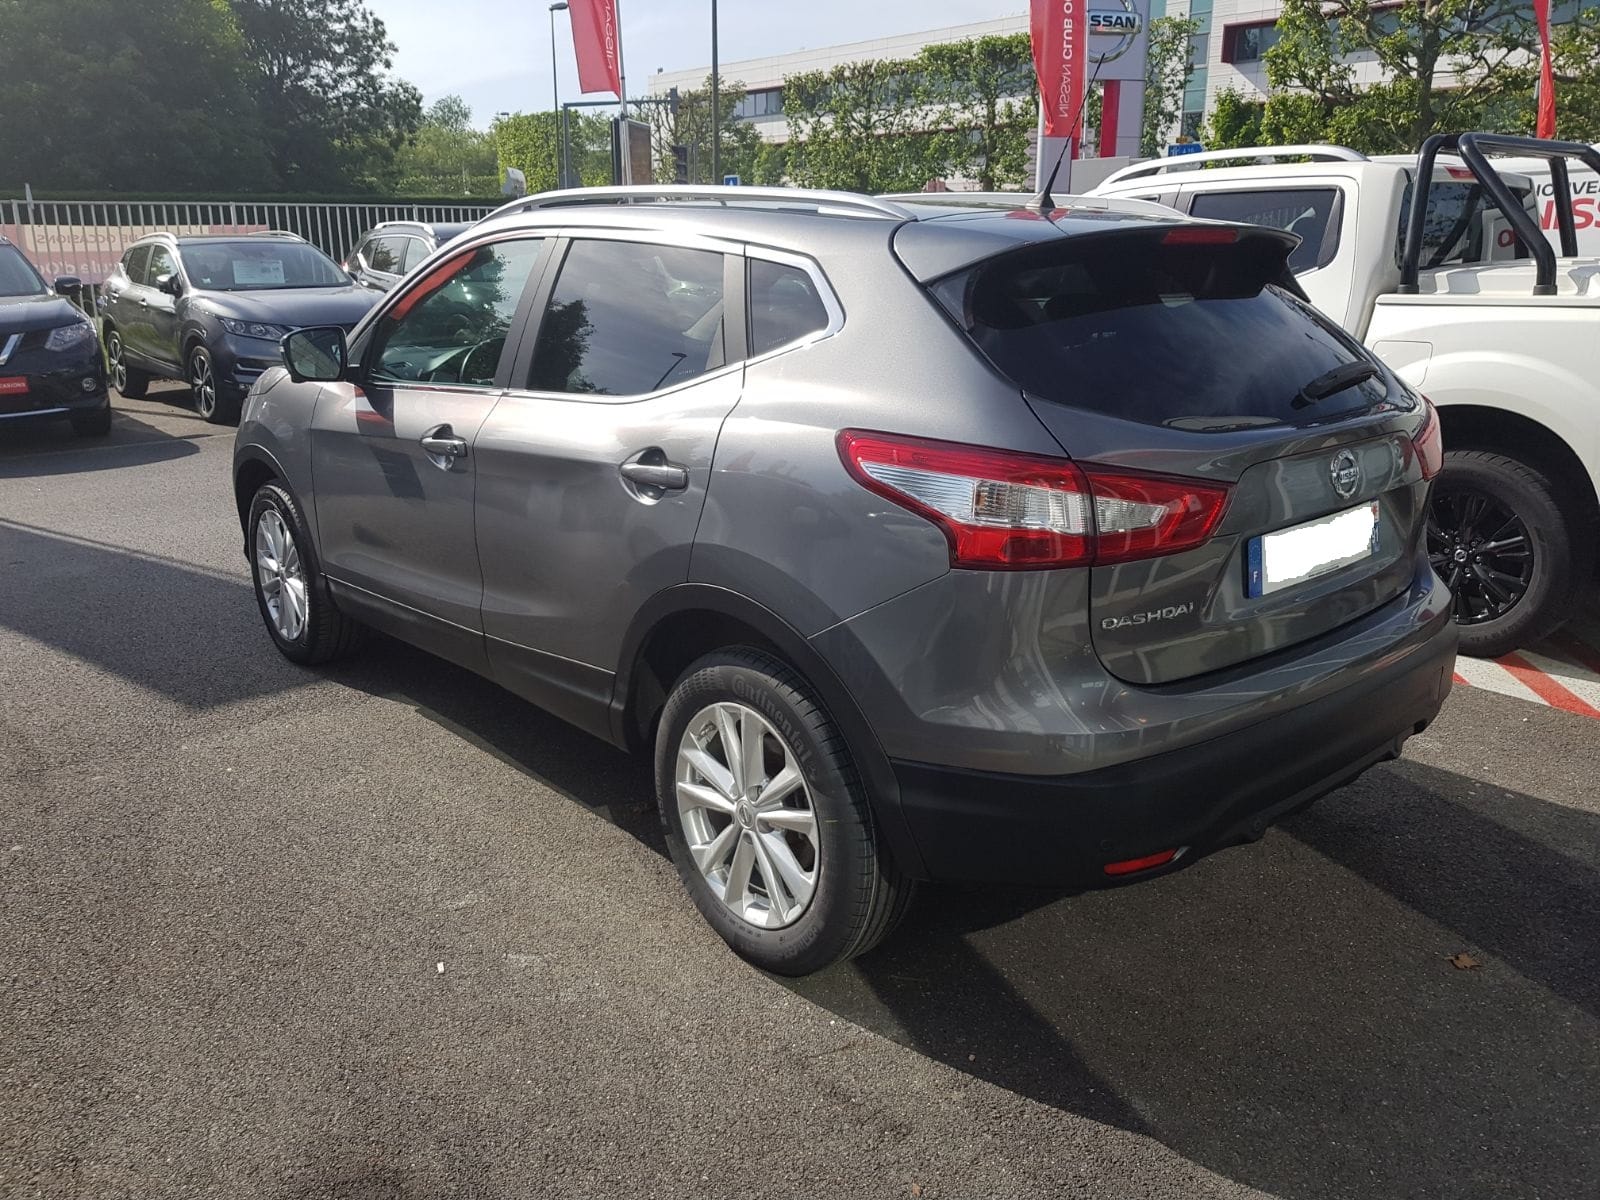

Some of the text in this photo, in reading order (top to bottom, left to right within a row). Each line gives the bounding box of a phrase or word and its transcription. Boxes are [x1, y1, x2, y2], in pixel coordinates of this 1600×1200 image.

[1090, 15, 1136, 29] SSAN
[1252, 570, 1258, 584] F
[1102, 601, 1194, 630] QASHQAI
